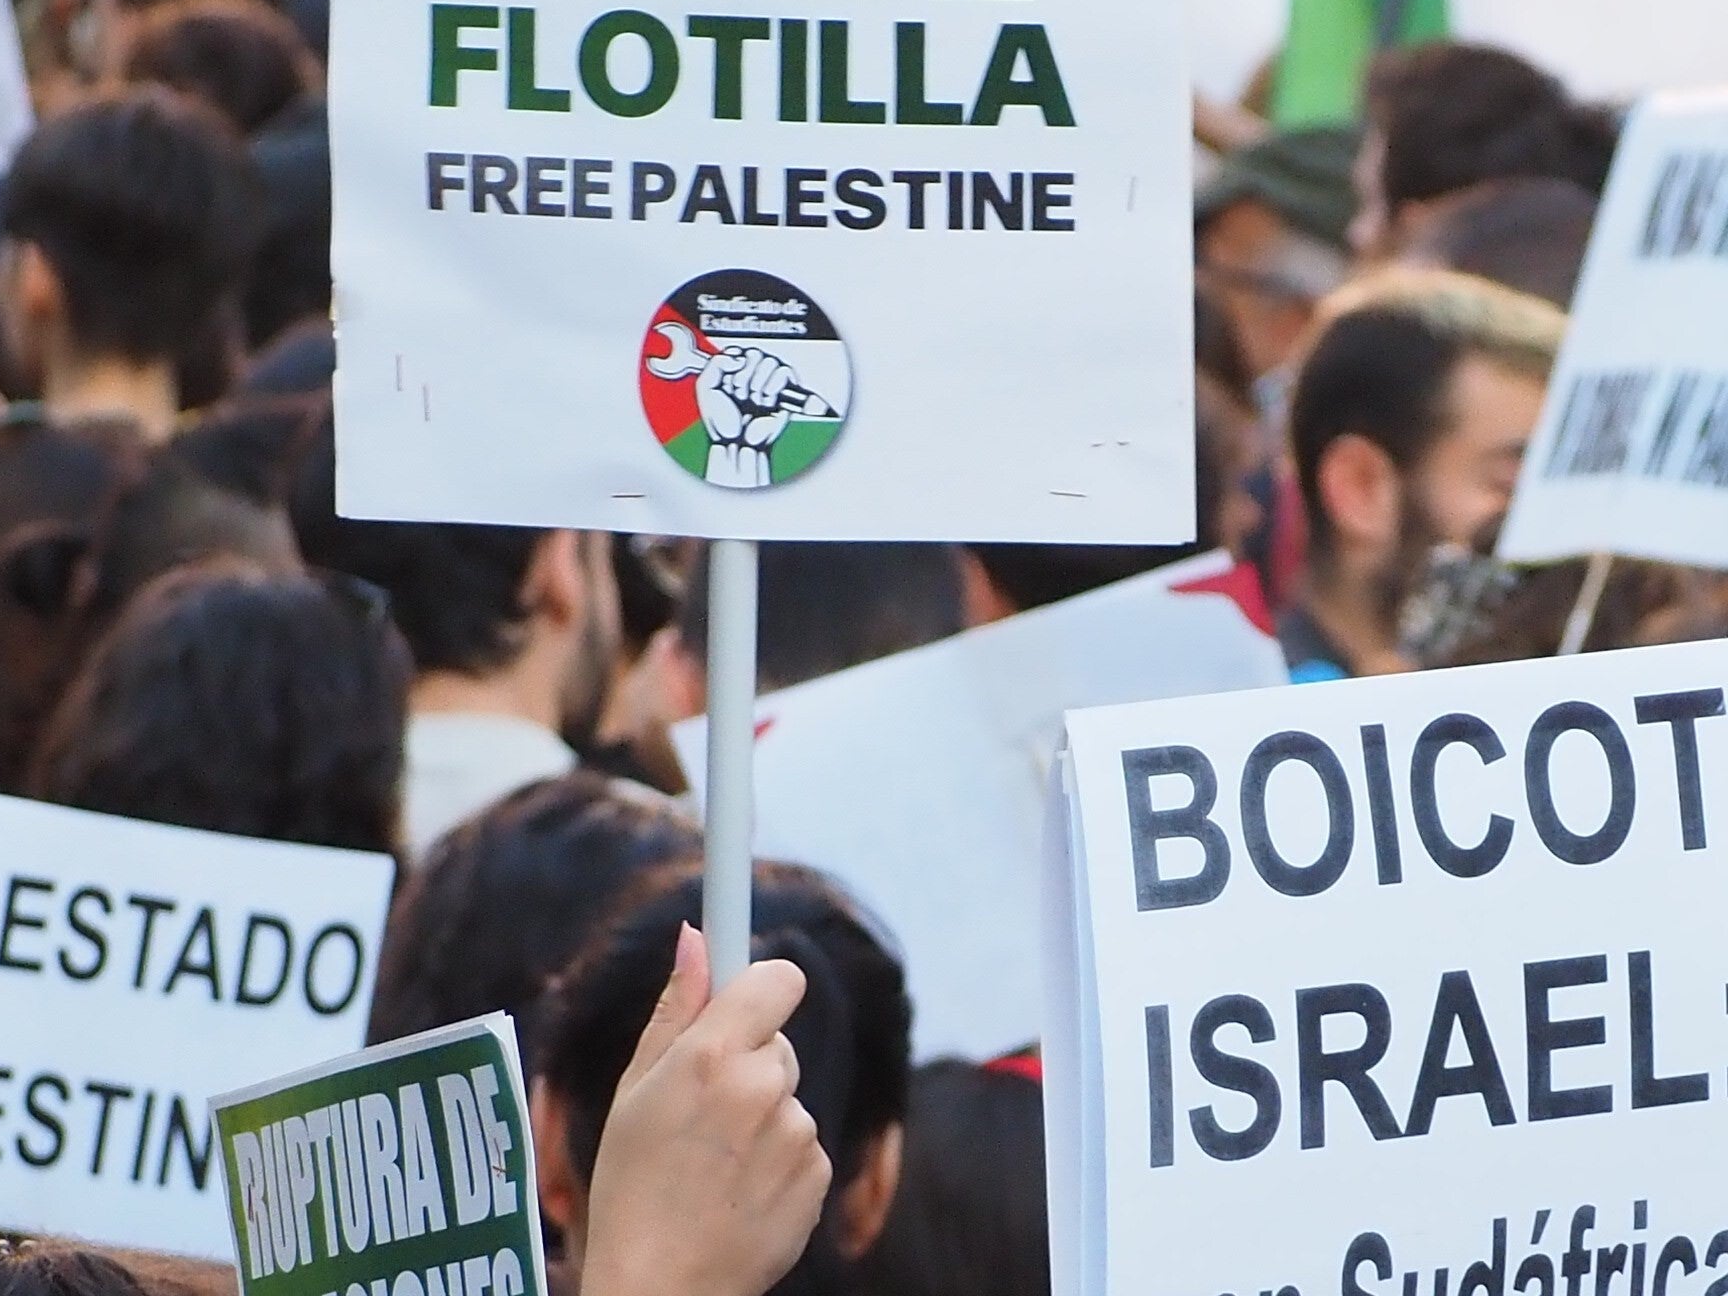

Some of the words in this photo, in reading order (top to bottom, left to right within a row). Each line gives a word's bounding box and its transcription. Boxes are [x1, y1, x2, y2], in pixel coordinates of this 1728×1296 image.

[428, 5, 1076, 128] FLOTILLA
[425, 152, 614, 220] FREE
[632, 161, 1076, 232] PALESTINE
[1120, 687, 1727, 912] BOICOT
[232, 1082, 447, 1281] RUPTURA
[437, 1064, 518, 1227] DE
